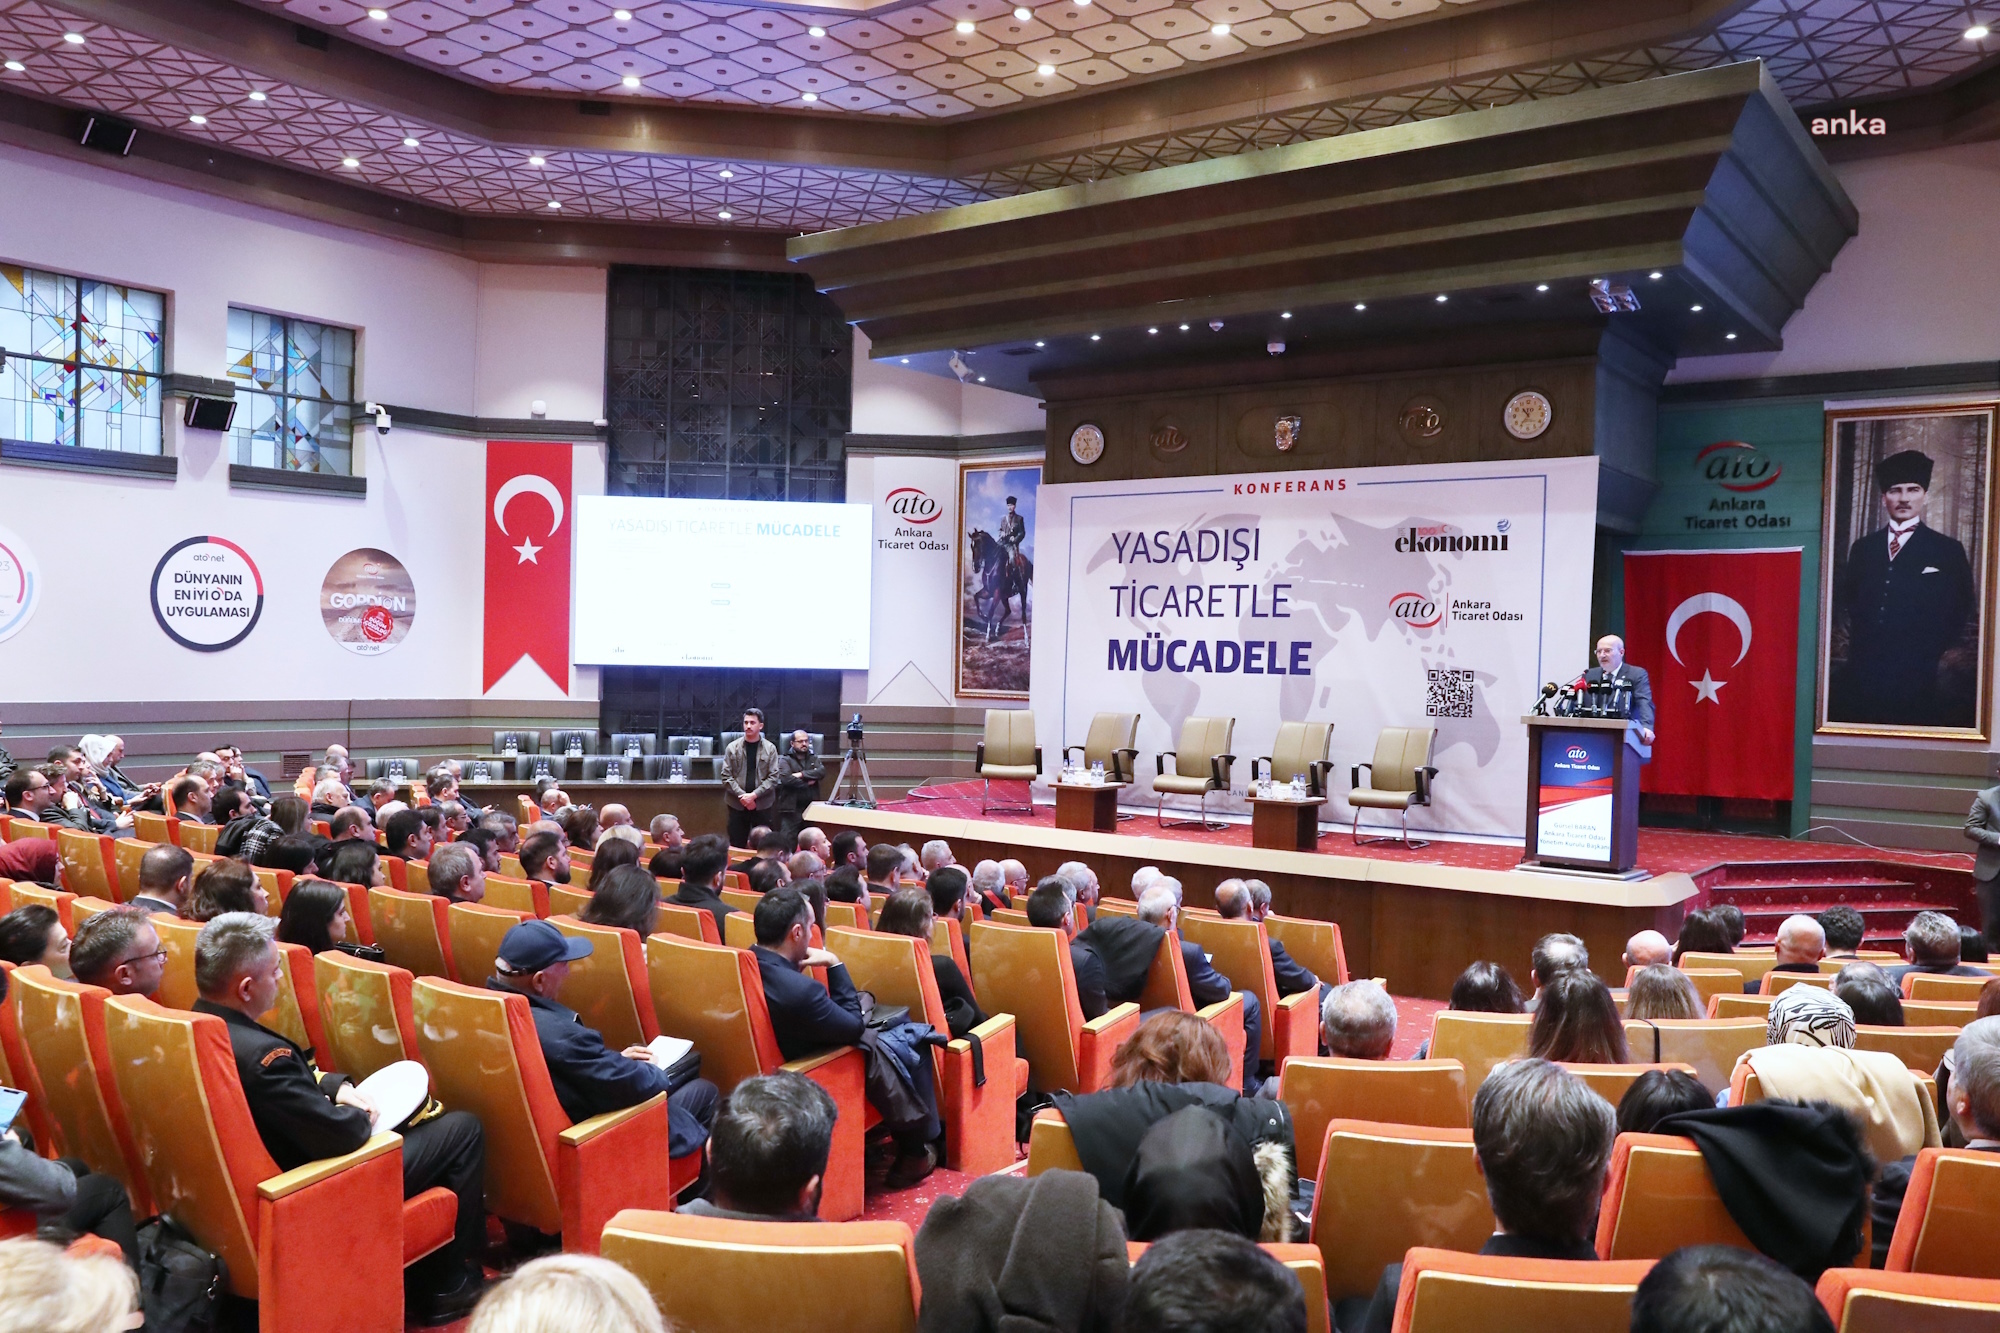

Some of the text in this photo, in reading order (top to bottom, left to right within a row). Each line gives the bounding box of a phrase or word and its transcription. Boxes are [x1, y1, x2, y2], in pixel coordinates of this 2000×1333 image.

[1706, 454, 1770, 479] ato
[1234, 479, 1346, 495] KONFERANS
[893, 494, 935, 515] ato
[1709, 497, 1766, 511] Ankara
[756, 520, 840, 537] MÜCADELE
[1684, 514, 1791, 529] Ticaret Odası
[895, 527, 933, 537] Ankara
[878, 539, 949, 551] Ticaret Odası
[1394, 528, 1508, 553] ekonomi
[1111, 528, 1260, 571] YASADIŞI
[174, 570, 242, 585] DÜNYANIN
[174, 589, 191, 601] EN
[193, 587, 209, 601] İYİ
[1109, 579, 1292, 618] TİCARETLE
[166, 606, 250, 617] UYGULAMASI
[1395, 599, 1435, 618] ato
[1452, 600, 1491, 609] Ankara
[1452, 611, 1523, 621] Ticaret Odası
[1107, 632, 1312, 676] MÜCADELE
[1568, 749, 1587, 759] ato
